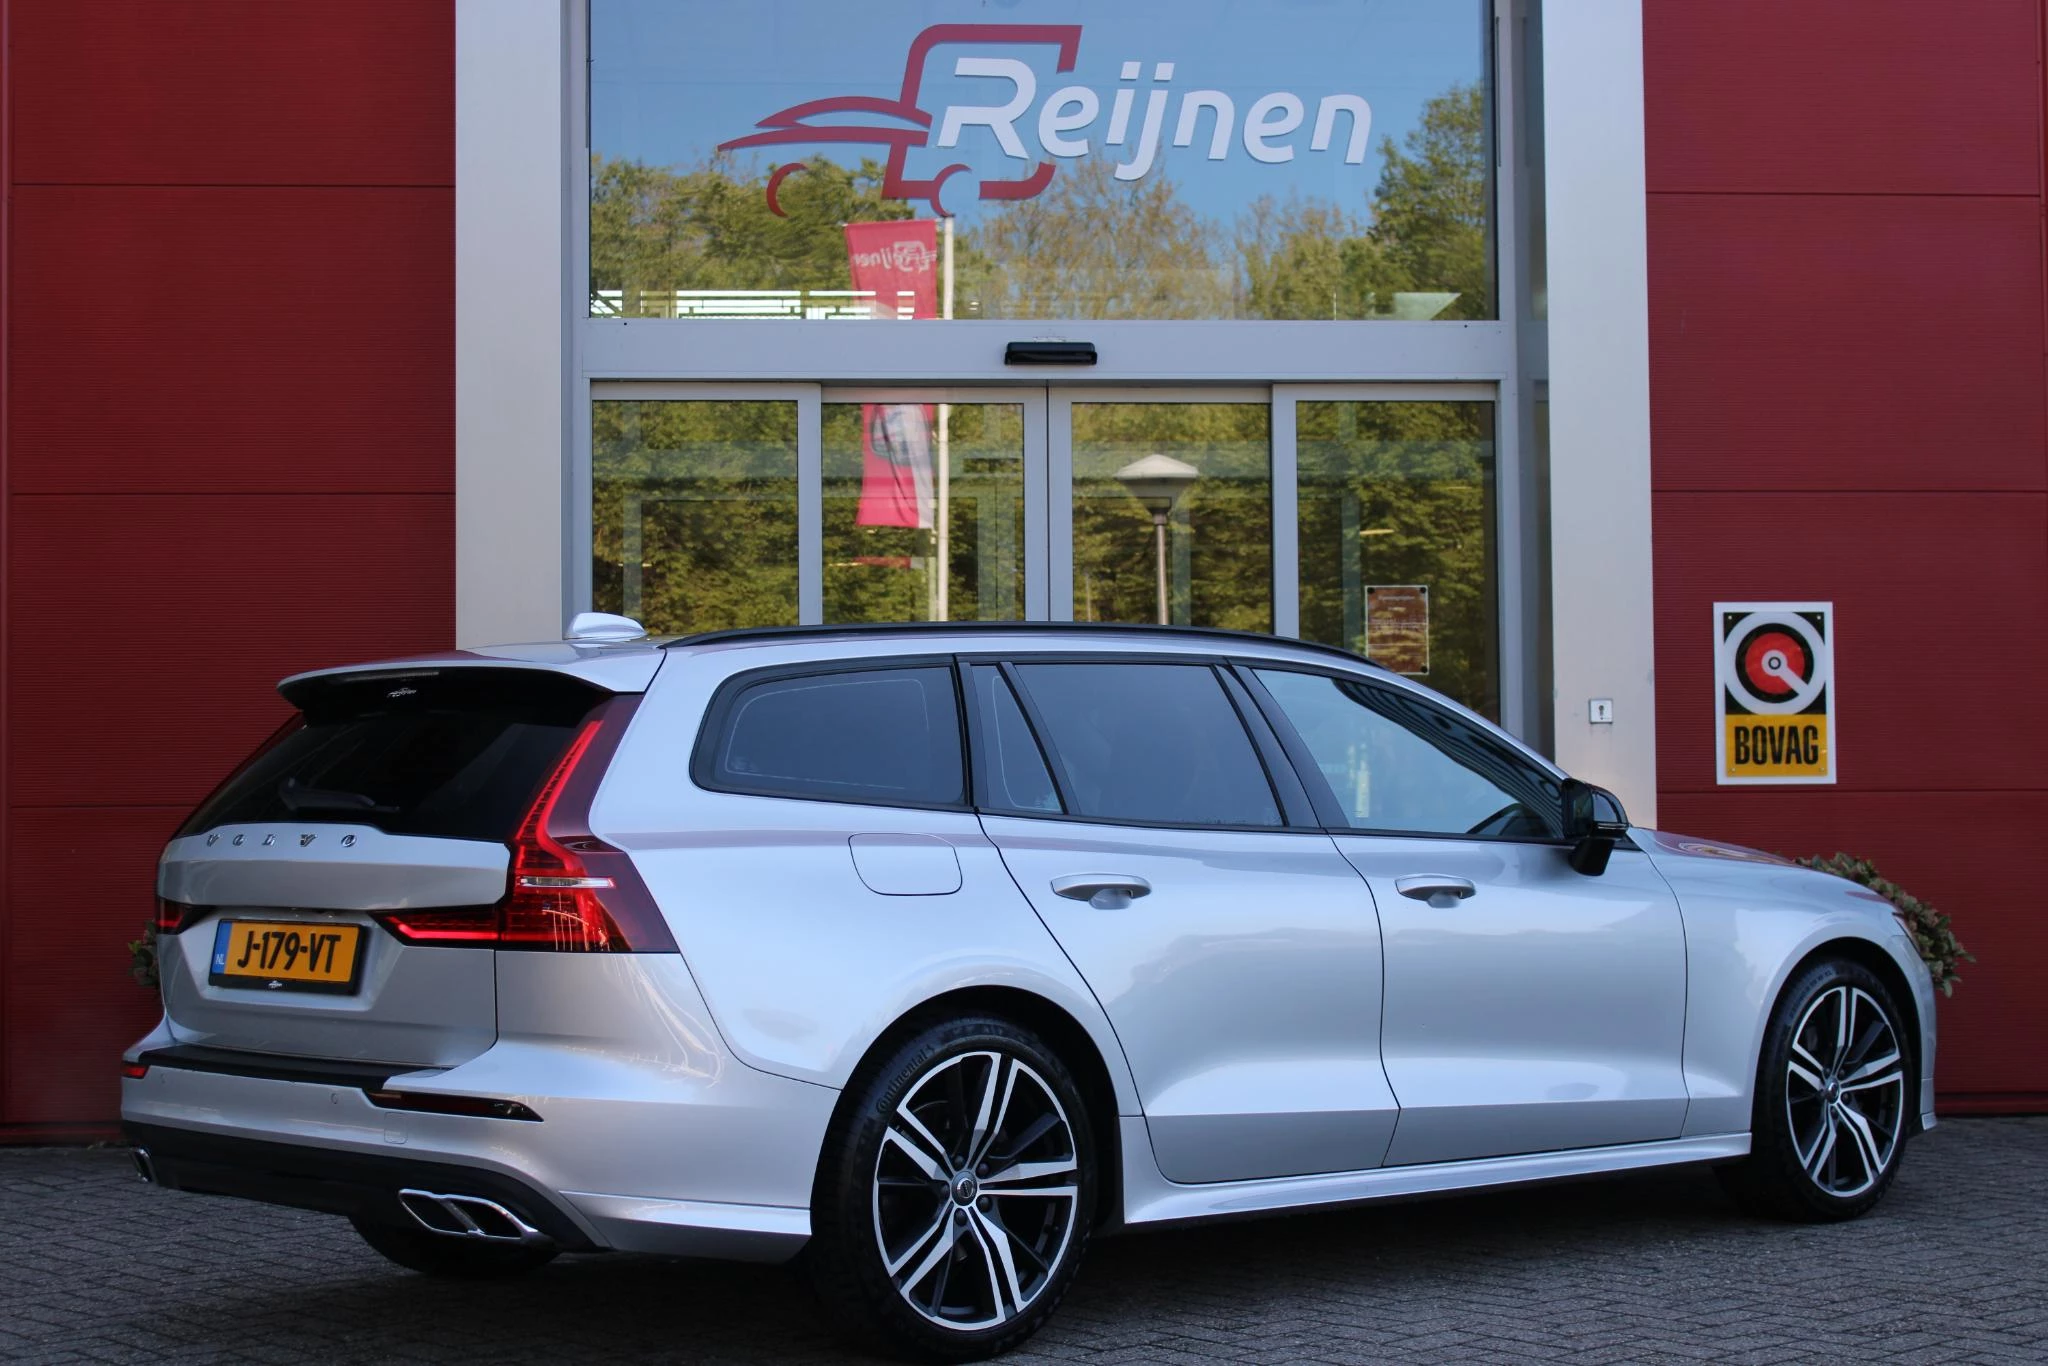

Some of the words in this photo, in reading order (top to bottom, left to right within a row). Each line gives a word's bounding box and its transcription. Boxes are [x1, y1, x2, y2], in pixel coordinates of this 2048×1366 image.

[936, 57, 1372, 181] Reijnen
[1734, 724, 1819, 765] BOVAG
[207, 833, 357, 848] VOLVO
[237, 931, 341, 974] J-179-VT
